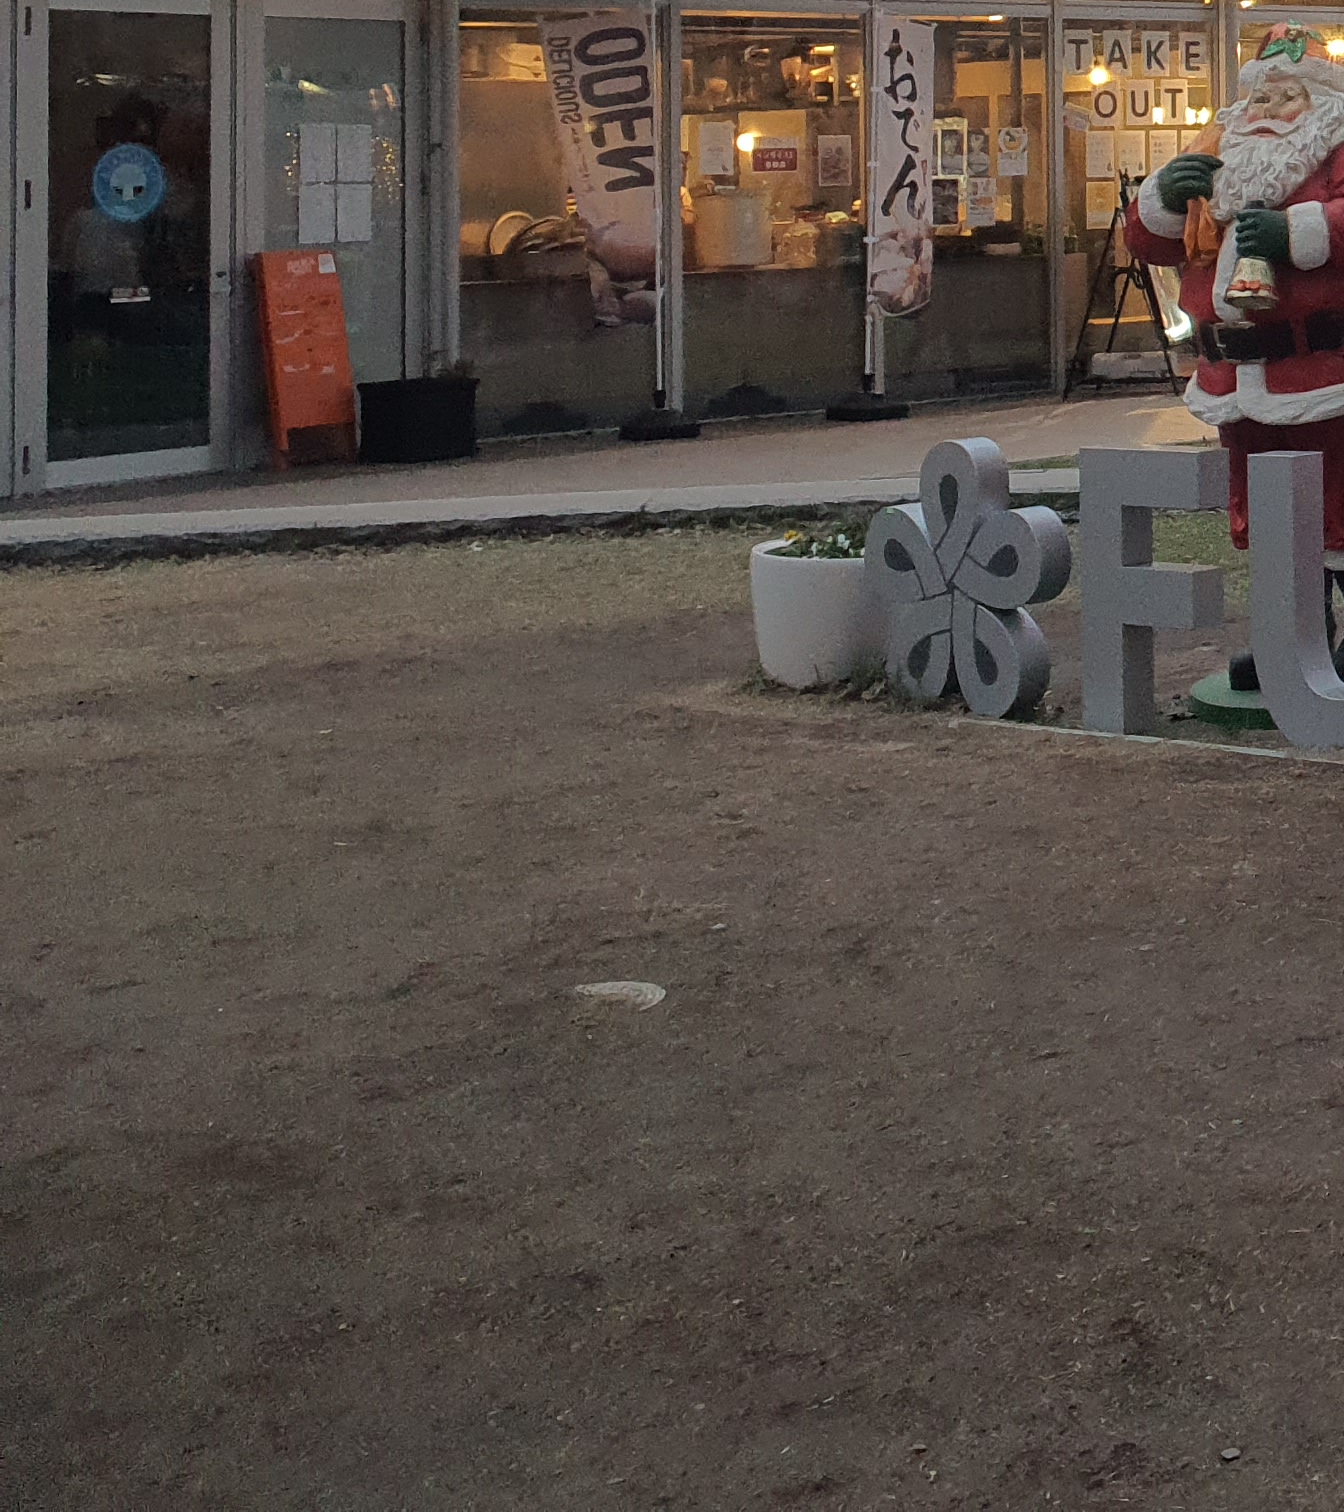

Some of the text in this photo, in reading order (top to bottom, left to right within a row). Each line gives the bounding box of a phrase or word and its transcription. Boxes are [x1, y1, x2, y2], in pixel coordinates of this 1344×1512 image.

[1066, 38, 1201, 71] TAKE
[1094, 88, 1184, 119] OUT
[880, 28, 921, 221] おでん
